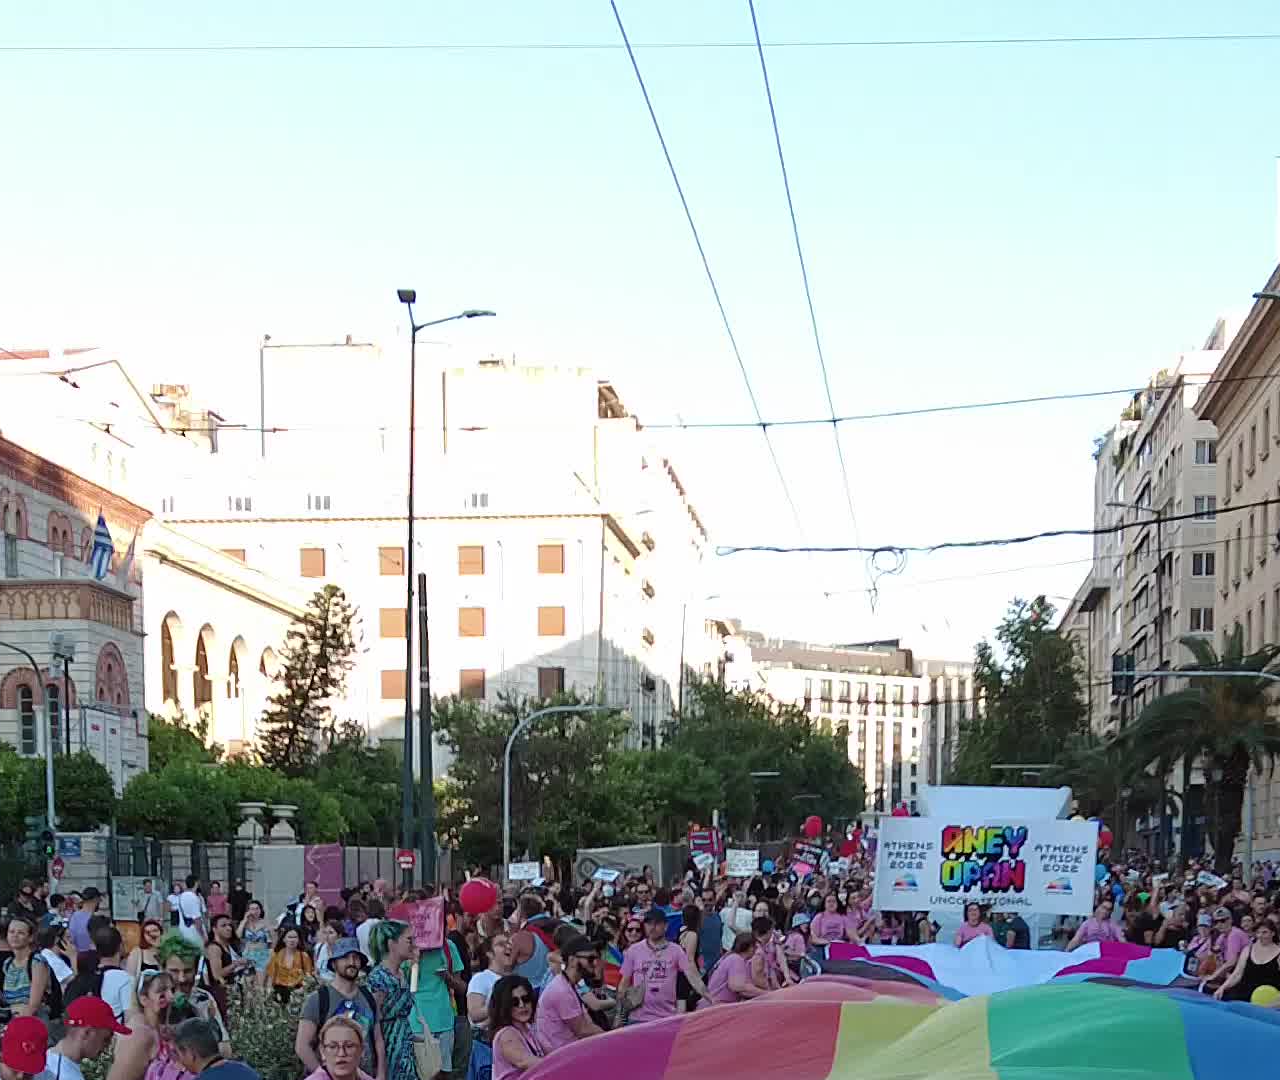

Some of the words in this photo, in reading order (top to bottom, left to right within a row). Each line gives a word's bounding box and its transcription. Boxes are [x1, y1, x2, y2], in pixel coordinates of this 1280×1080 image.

[883, 841, 934, 850] ATHENS
[1034, 844, 1089, 854] ATHENS
[887, 851, 927, 860] PRIDE
[1041, 854, 1082, 863] PRIDE
[889, 861, 923, 869] 2022
[1043, 864, 1079, 873] 2022
